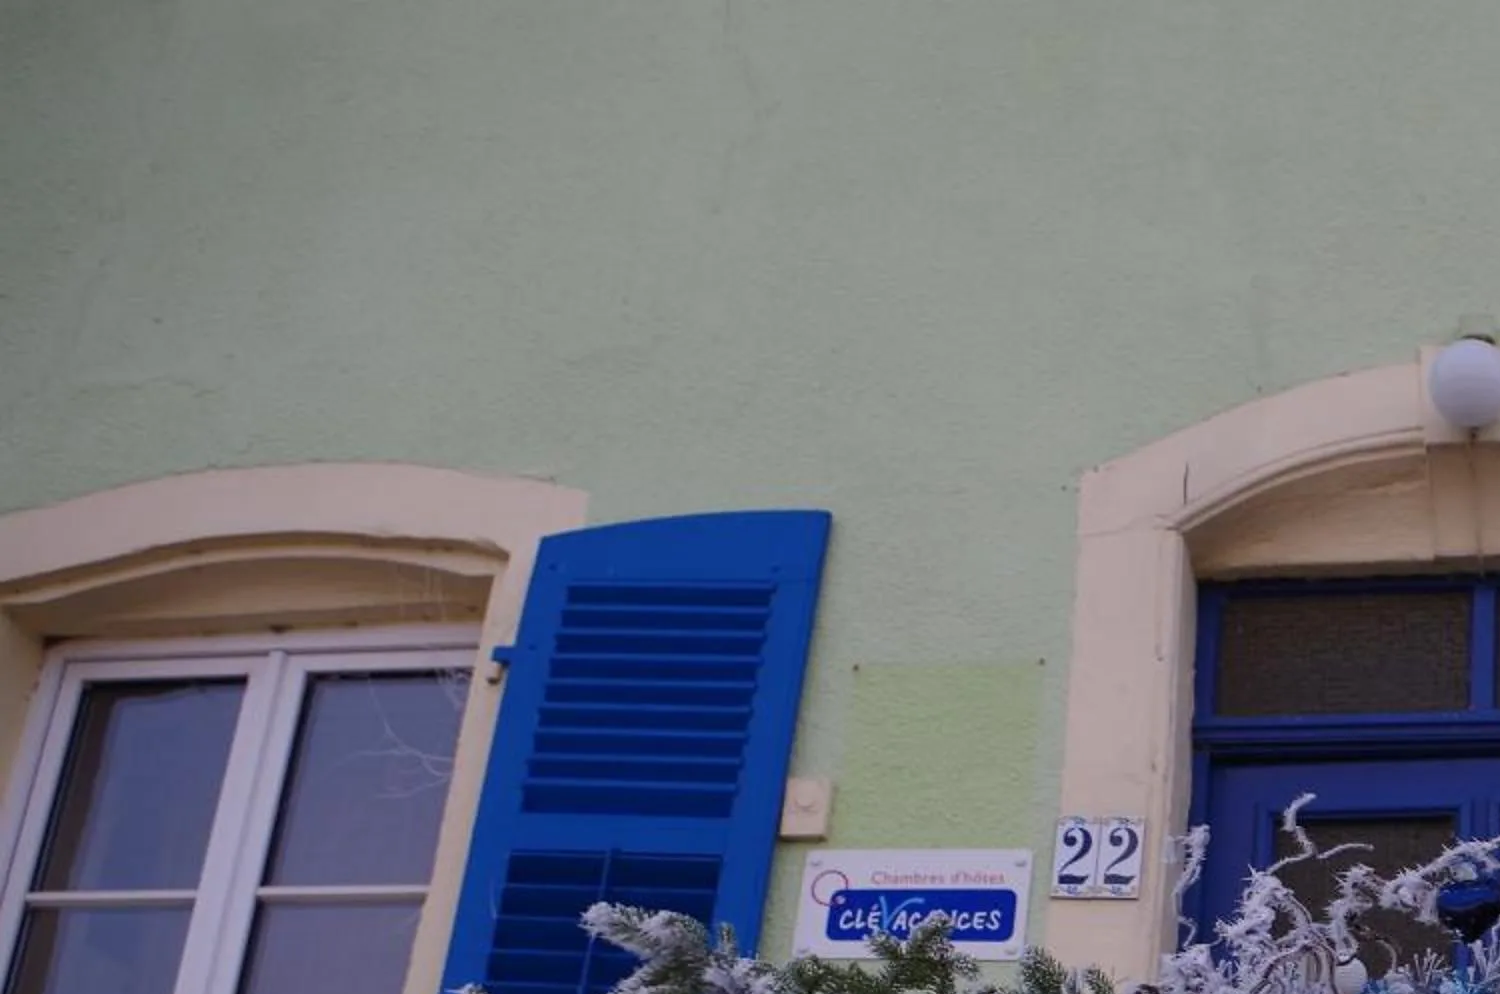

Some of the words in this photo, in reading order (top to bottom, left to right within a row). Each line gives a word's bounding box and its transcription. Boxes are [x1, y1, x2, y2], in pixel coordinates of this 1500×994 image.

[1058, 827, 1139, 885] 22
[870, 870, 945, 886] Chambres
[949, 869, 1005, 885] d'hôtes
[839, 895, 1001, 931] CLÉVACCES
